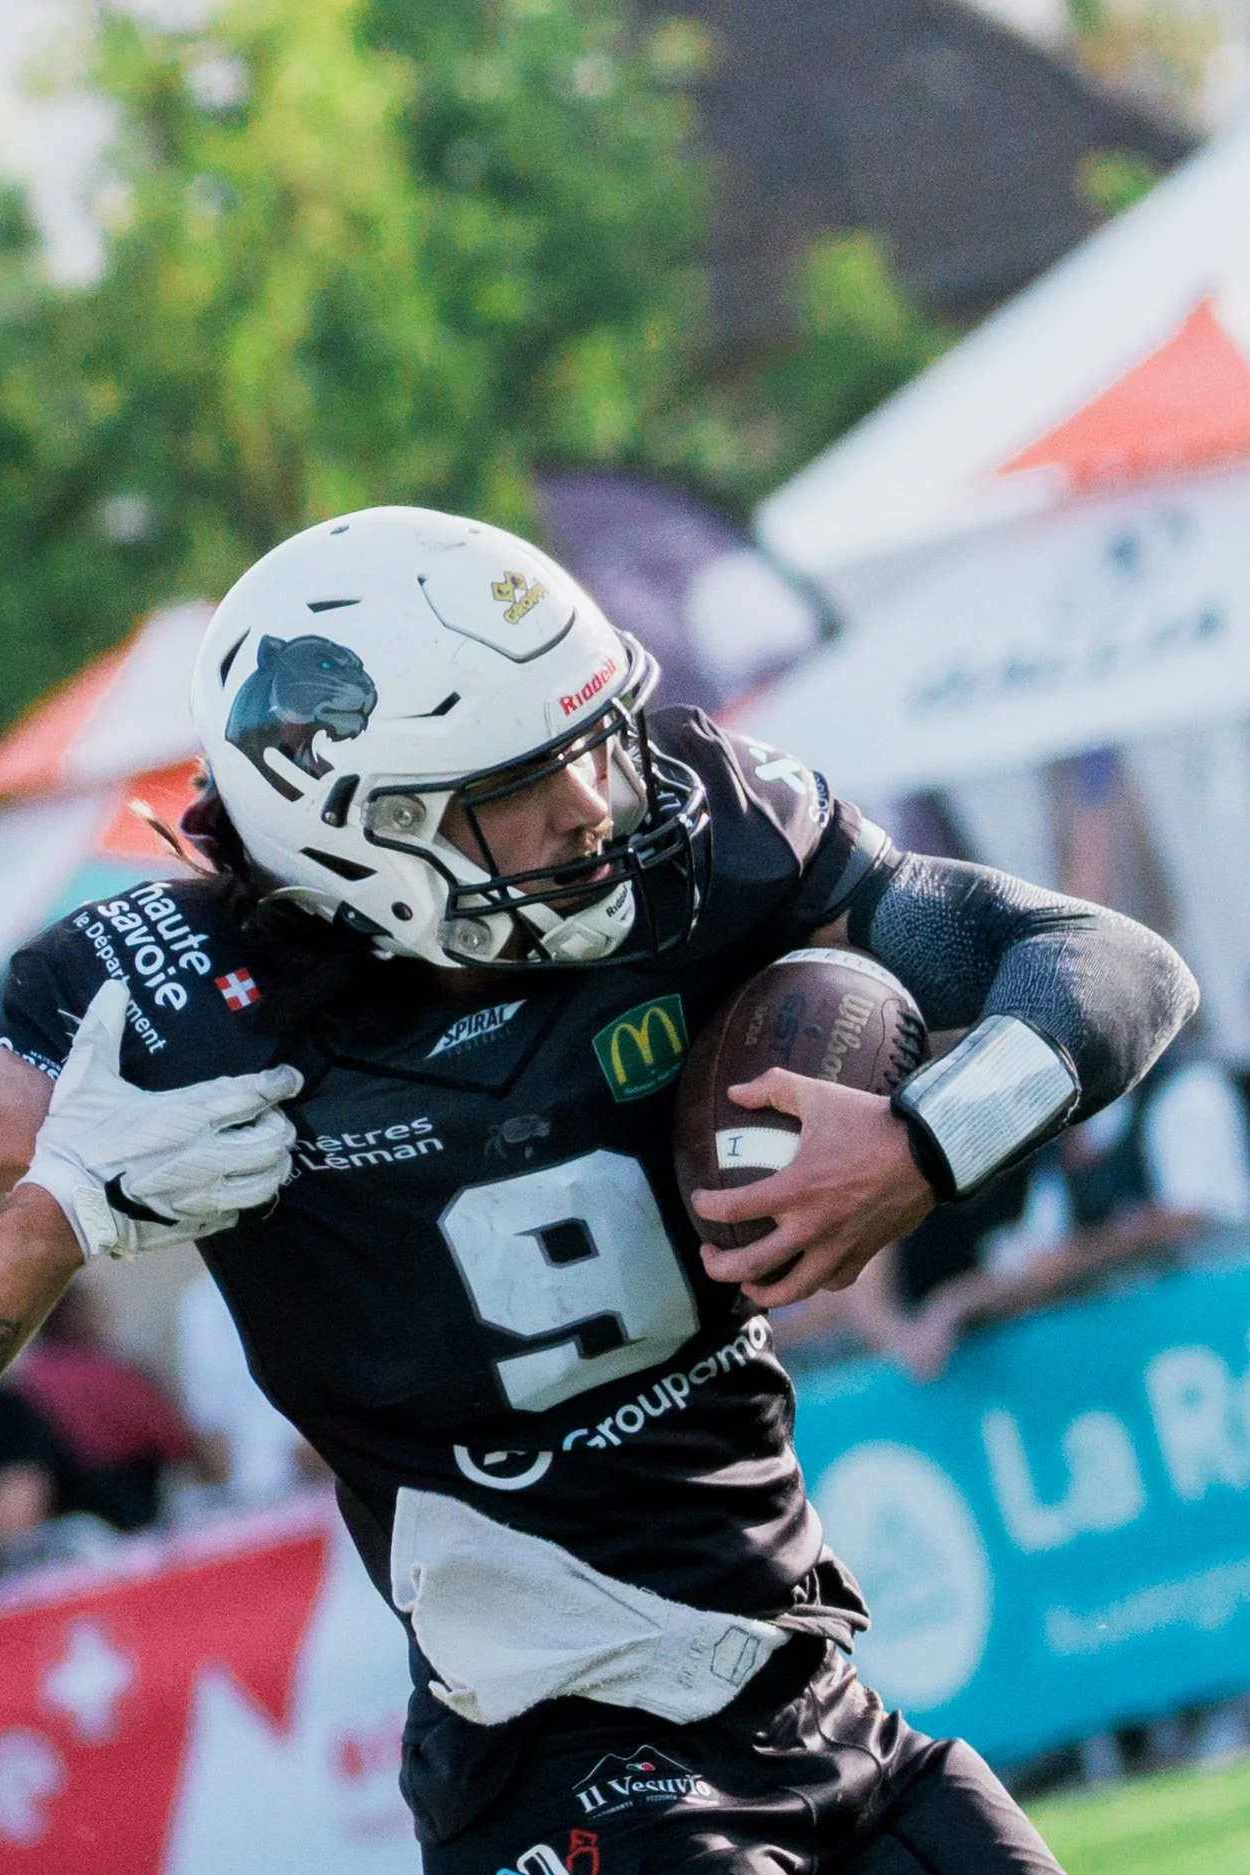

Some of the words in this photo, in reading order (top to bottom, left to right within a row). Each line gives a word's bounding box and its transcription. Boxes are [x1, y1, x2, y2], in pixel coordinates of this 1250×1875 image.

[558, 658, 616, 716] Riddell
[97, 900, 188, 1011] savoie
[130, 882, 212, 975] haute
[85, 921, 167, 1054] Départment
[297, 1137, 444, 1171] Léman
[439, 1149, 700, 1413] 9
[575, 1785, 607, 1813] Il
